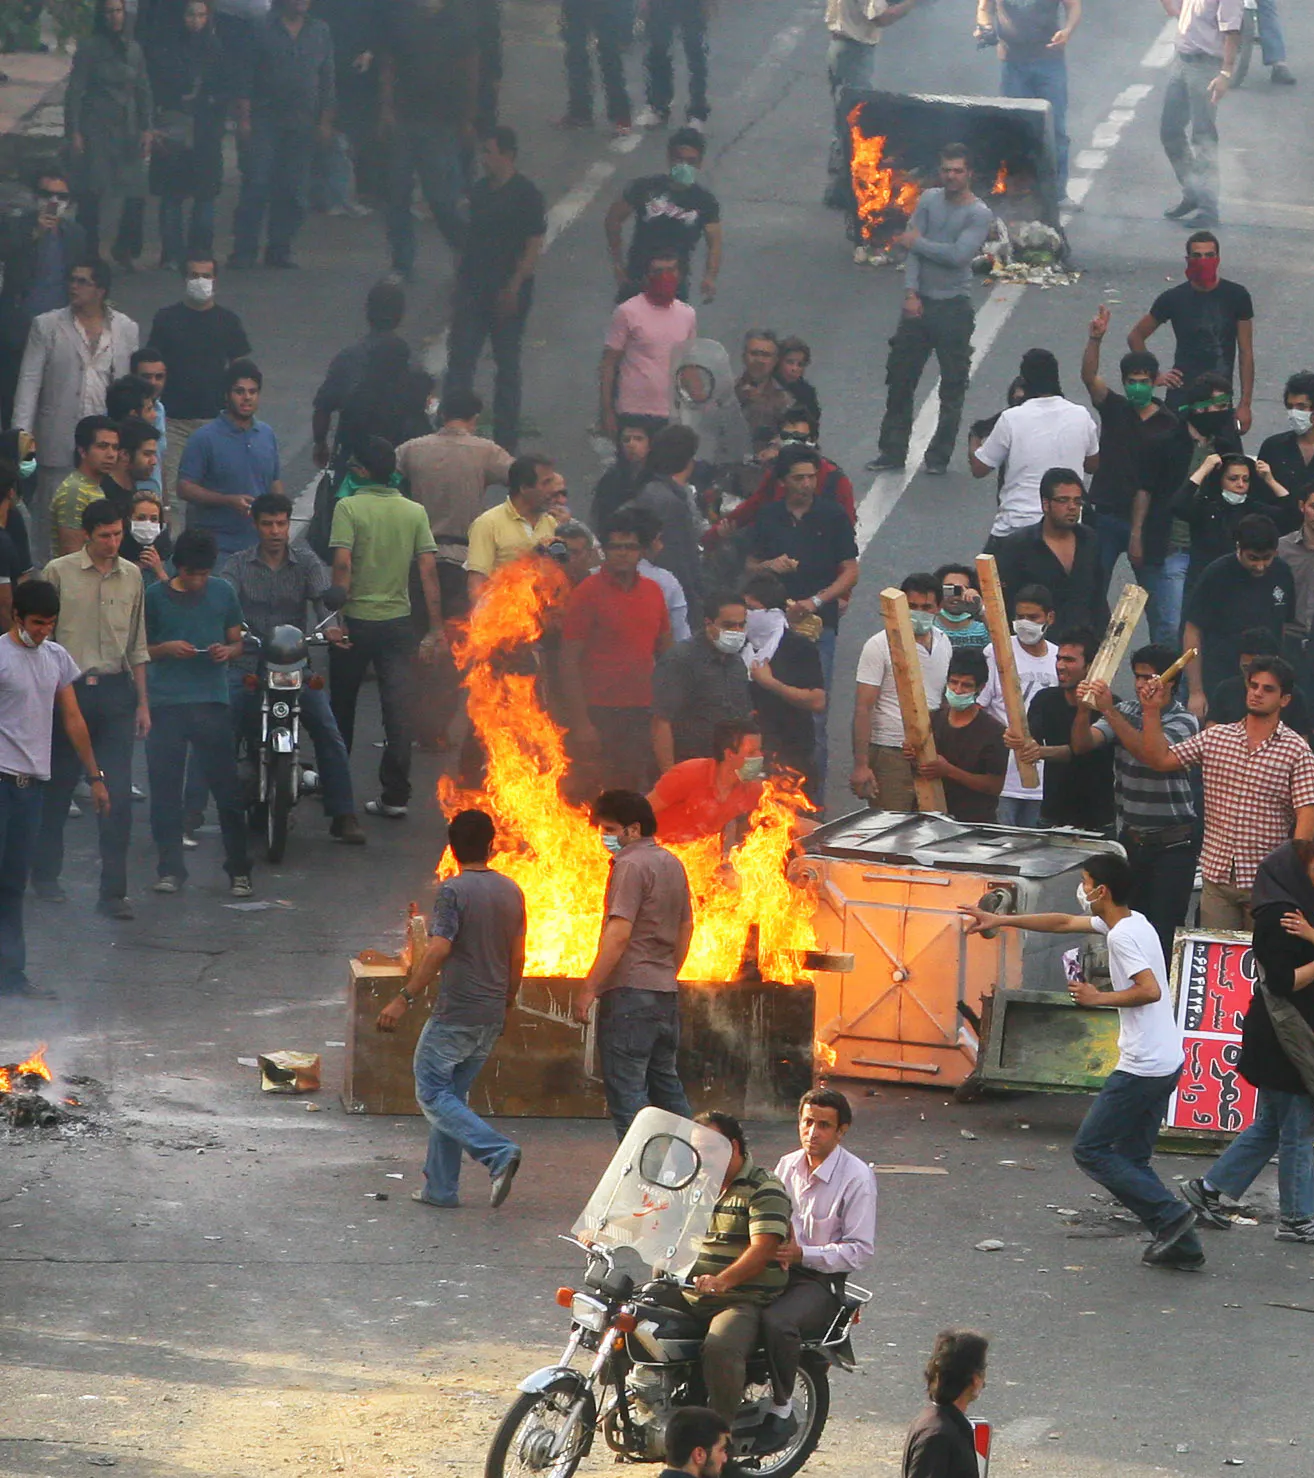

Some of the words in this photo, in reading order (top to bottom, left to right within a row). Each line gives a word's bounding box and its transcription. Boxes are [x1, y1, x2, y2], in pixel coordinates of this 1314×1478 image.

[1211, 945, 1235, 992] کنید
[1209, 989, 1233, 1031] سفر
[1182, 1041, 1207, 1104] واجب
[1209, 1044, 1245, 1132] عمره
[1194, 1109, 1213, 1125] و
